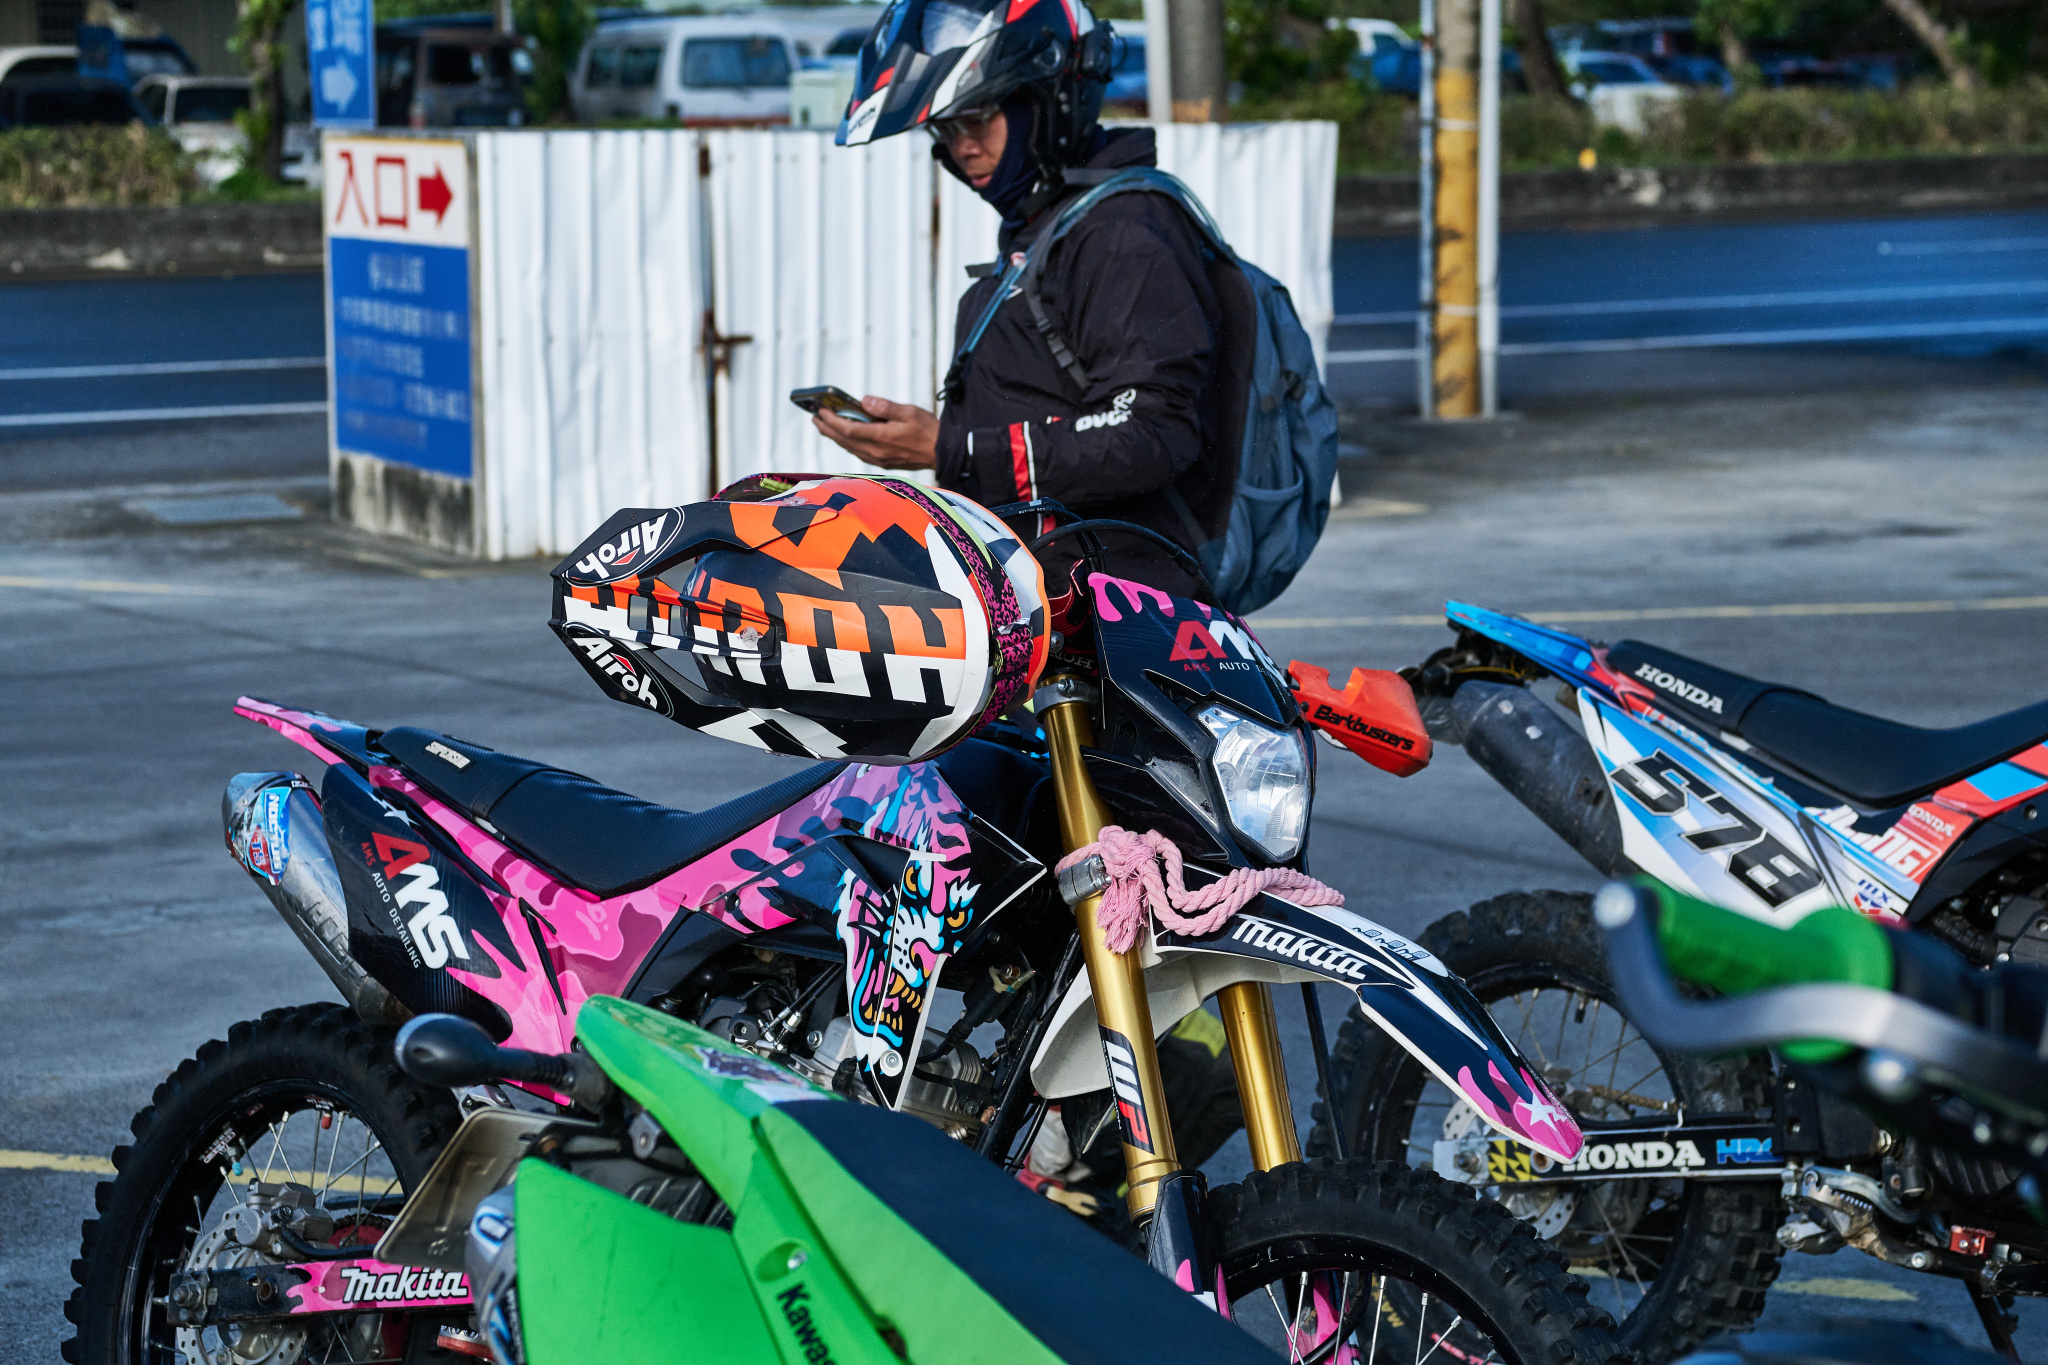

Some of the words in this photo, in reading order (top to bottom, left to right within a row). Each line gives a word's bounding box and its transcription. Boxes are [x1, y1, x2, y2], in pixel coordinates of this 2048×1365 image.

[335, 149, 408, 229] 入口
[575, 512, 669, 580] Airoh
[572, 637, 658, 710] Airoh
[1183, 662, 1211, 672] AMS
[1219, 661, 1250, 671] AUTO
[1634, 662, 1724, 715] HONDA
[1313, 703, 1415, 751] Barkbusters
[1608, 747, 1825, 912] 578
[360, 842, 376, 867] AMS
[371, 872, 391, 903] AUTO
[388, 907, 421, 969] DETAILING
[371, 831, 470, 970] AMS
[1562, 1139, 1706, 1172] HONDA
